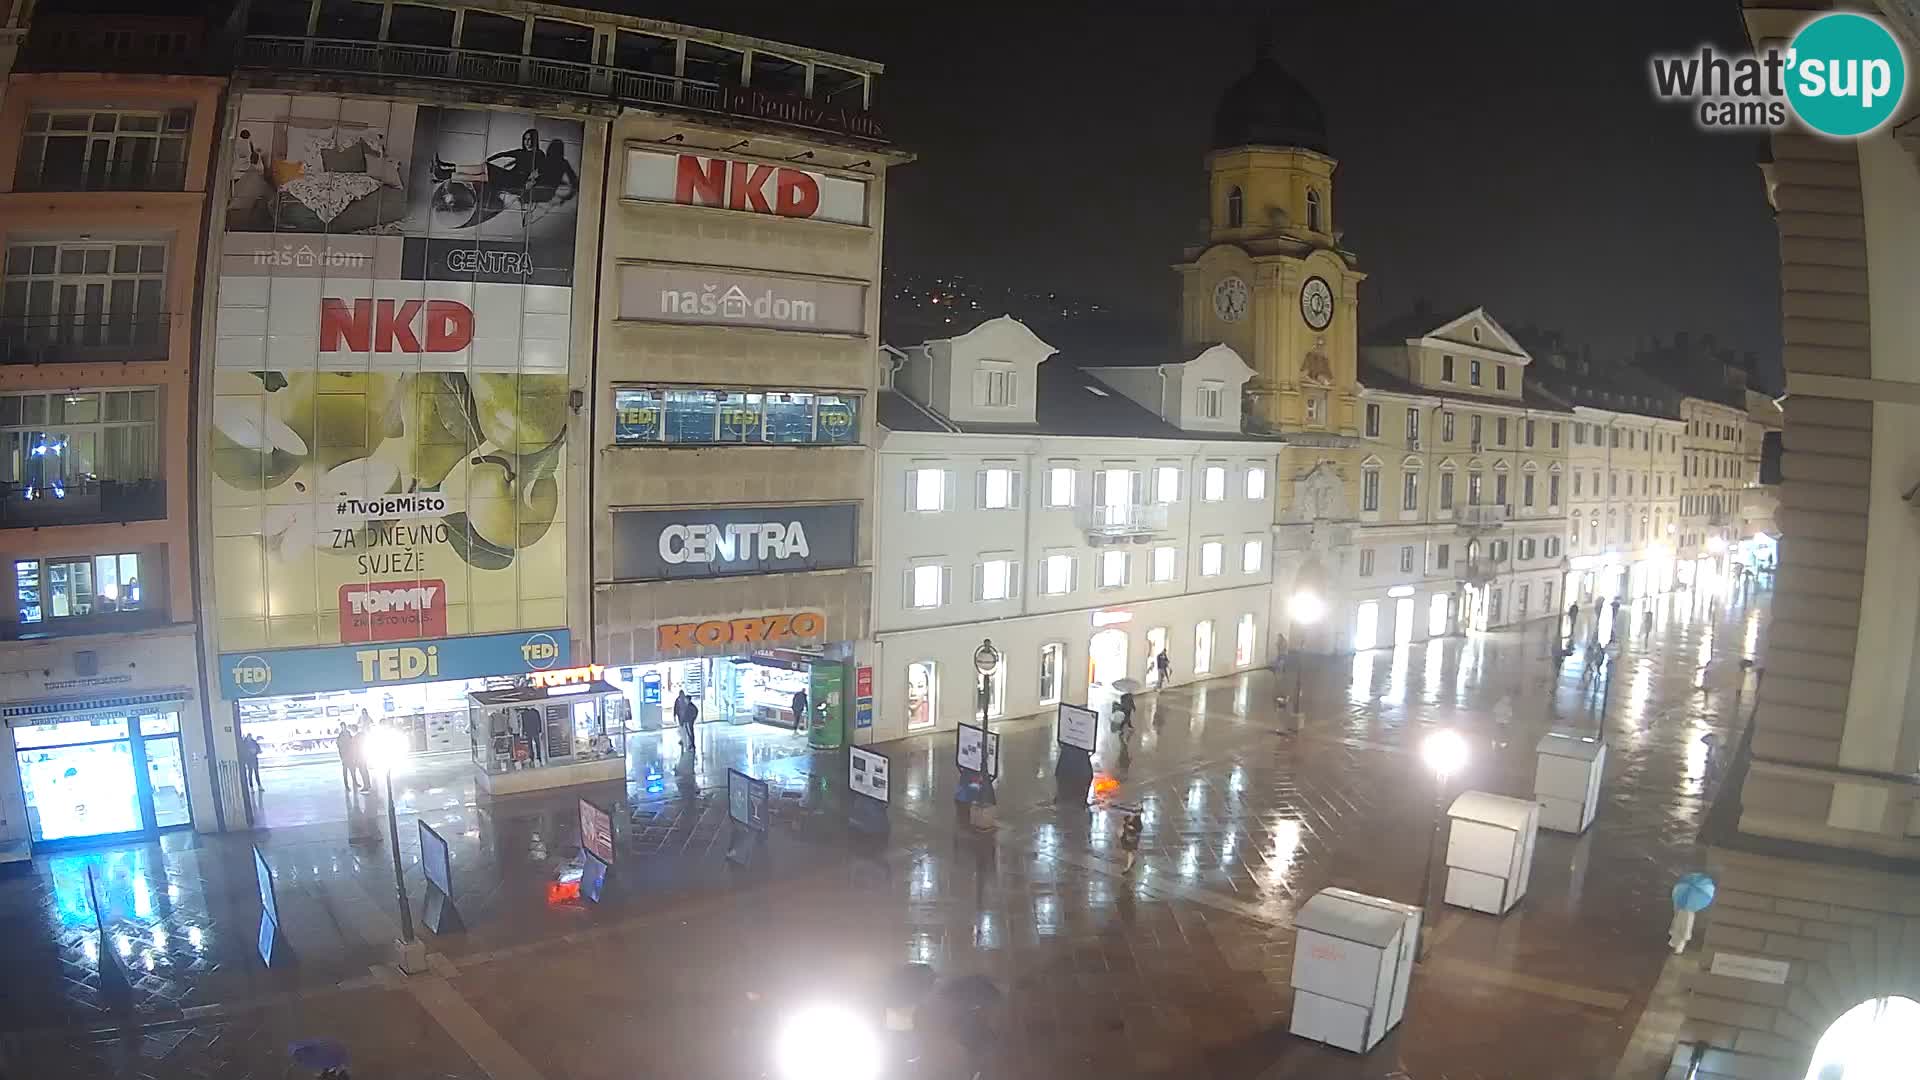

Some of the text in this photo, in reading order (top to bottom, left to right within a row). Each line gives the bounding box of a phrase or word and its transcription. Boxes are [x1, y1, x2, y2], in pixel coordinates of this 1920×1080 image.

[675, 154, 820, 219] NKD
[253, 245, 364, 268] naš dom
[447, 249, 533, 275] CENTRA
[661, 283, 816, 322] naš dom
[319, 297, 475, 354] NKD
[336, 496, 445, 516] #TvojeMisto
[332, 523, 449, 549] ZA DNEVNO
[658, 520, 809, 564] CENTRA
[357, 547, 425, 576] SVJEŽE
[346, 587, 438, 616] TOMMY
[656, 612, 825, 651] KORZO
[356, 645, 438, 682] TEDi
[520, 642, 560, 661] TEDi
[232, 664, 272, 686] TEDi
